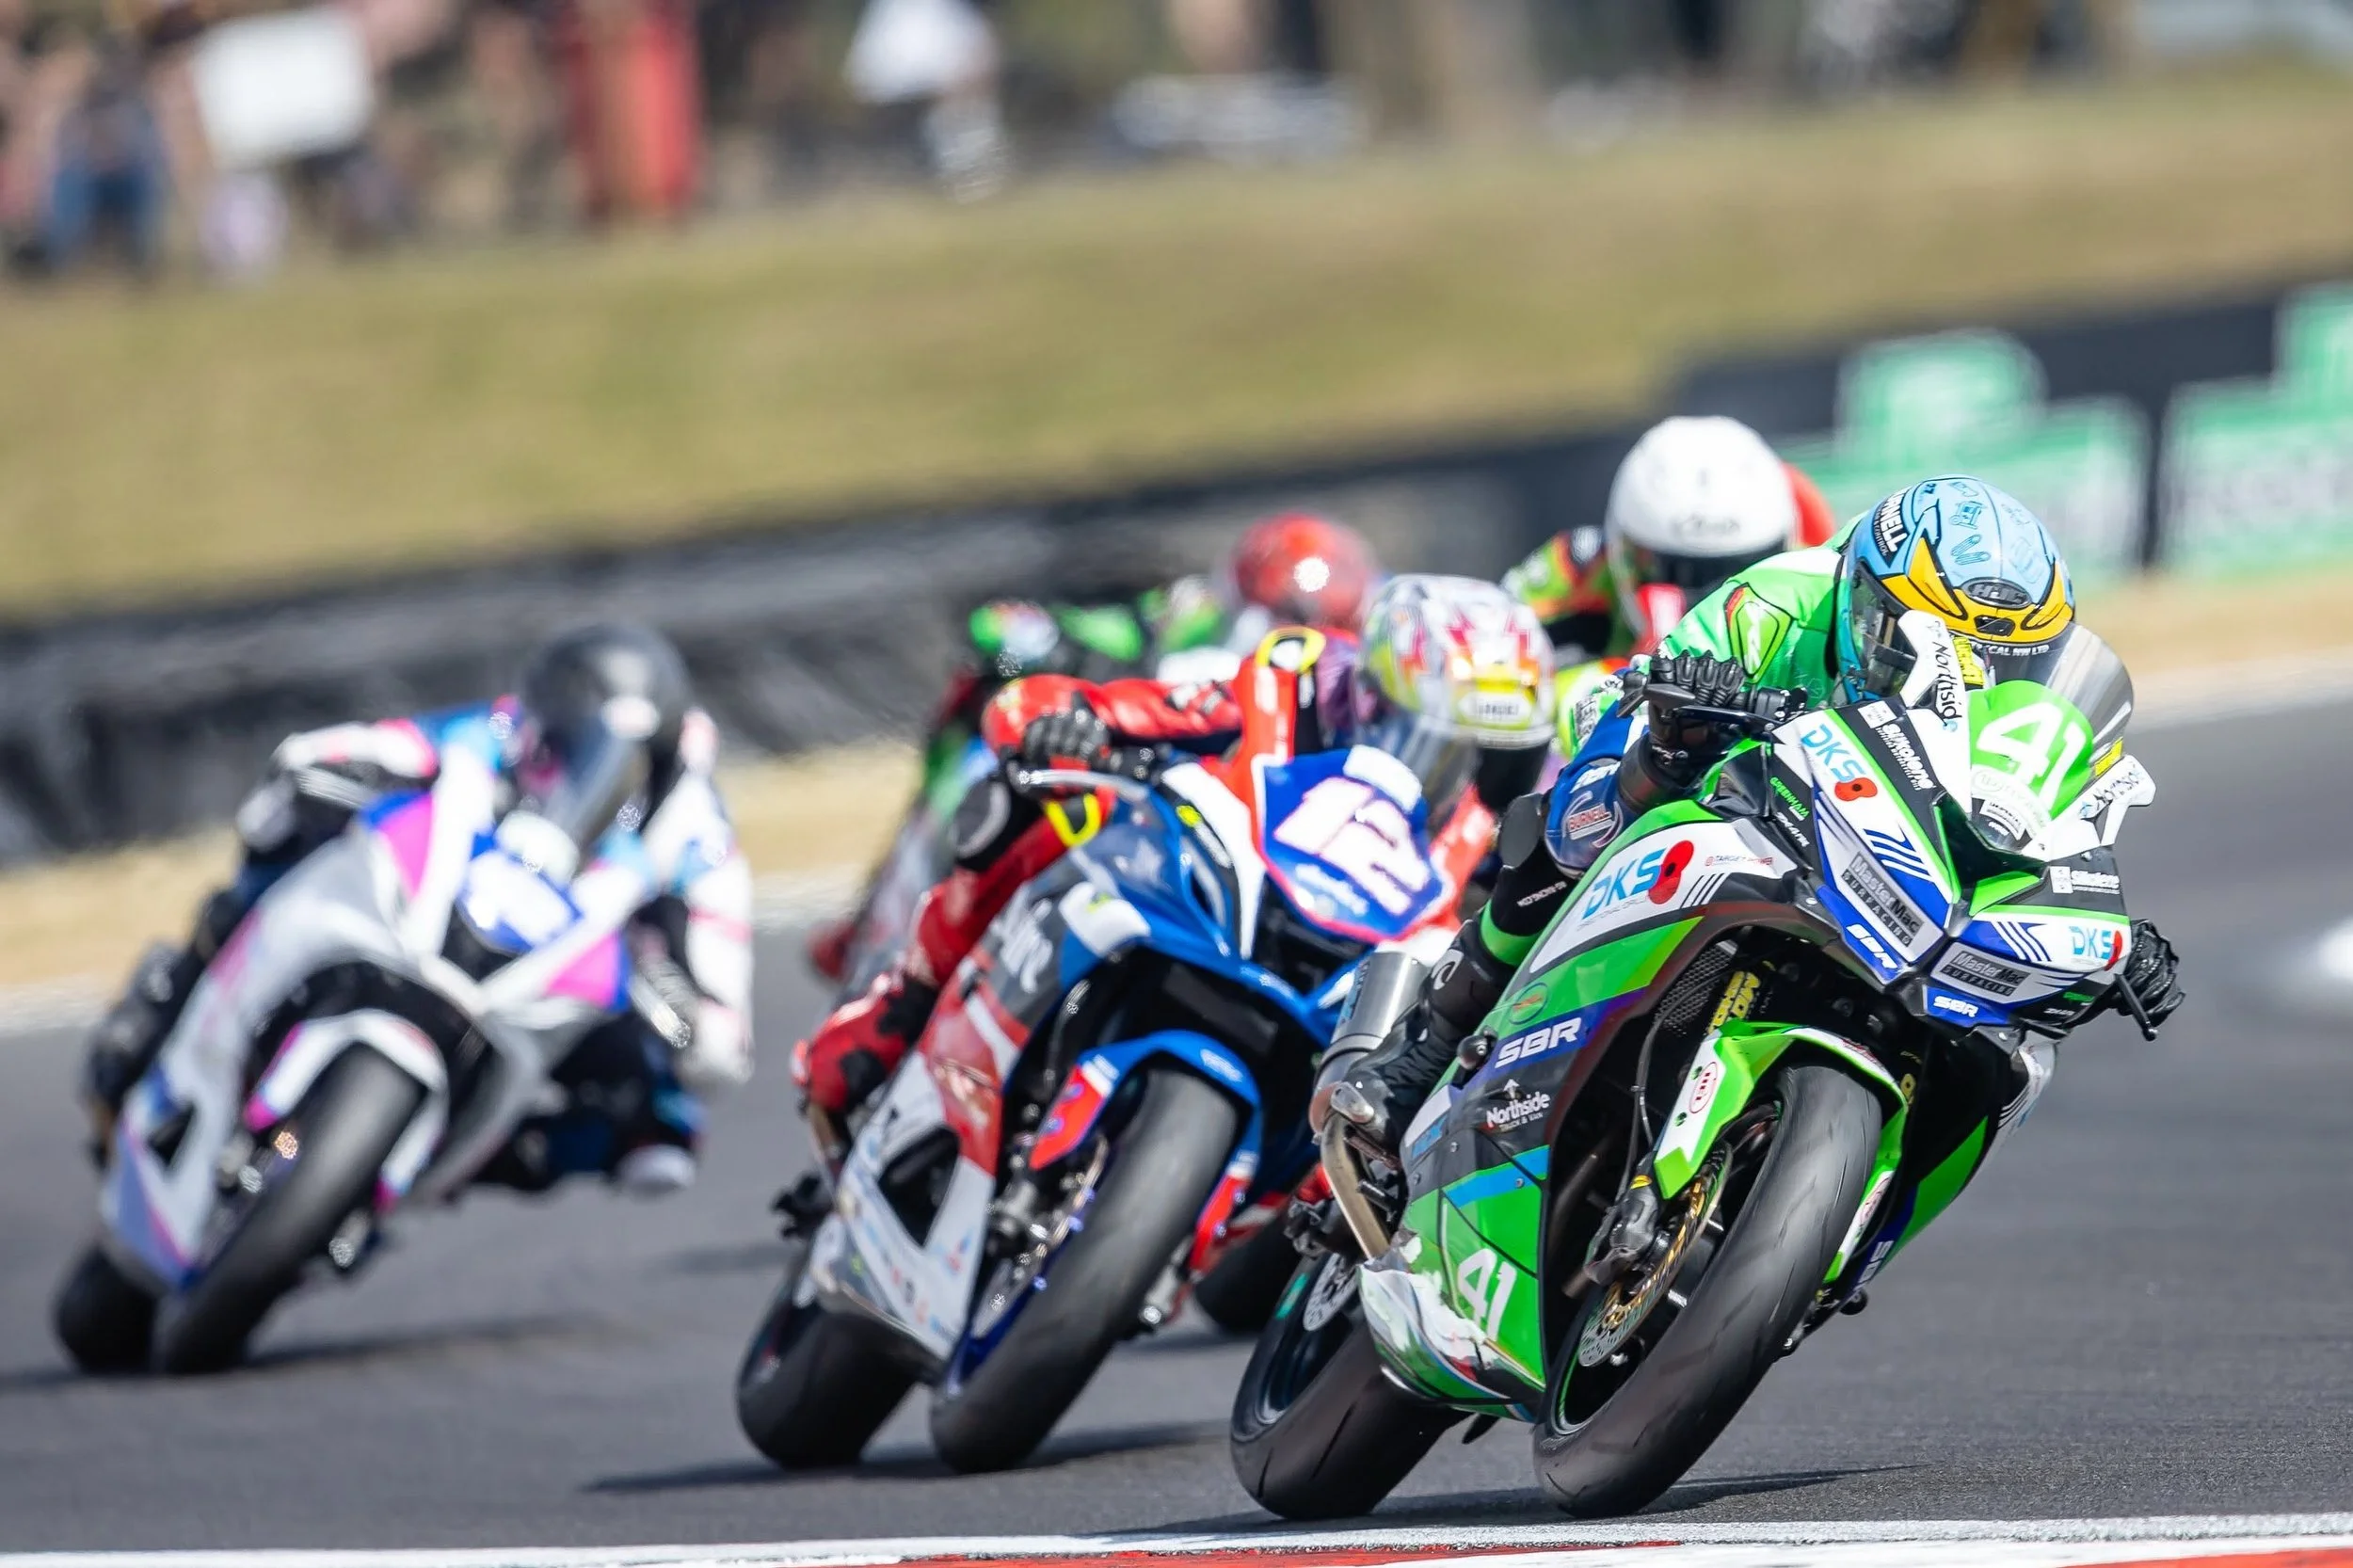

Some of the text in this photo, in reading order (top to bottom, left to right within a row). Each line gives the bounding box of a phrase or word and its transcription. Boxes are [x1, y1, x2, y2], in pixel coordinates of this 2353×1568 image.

[1969, 583, 2028, 605] HJC
[2032, 644, 2050, 655] LTD
[1801, 723, 1866, 782] DKS
[1977, 702, 2088, 817] 41
[1582, 847, 1668, 920] DKS
[1849, 855, 1921, 934] MasterMac
[1842, 870, 1911, 946] SURFACING
[2069, 926, 2112, 960] DKS
[1941, 965, 2014, 996] SURFACING
[1953, 951, 2025, 986] MasterMac
[1933, 995, 1979, 1018] SBR
[1495, 1016, 1582, 1069] SBR
[1486, 1090, 1551, 1128] Northside
[1457, 1247, 1517, 1342] 41
